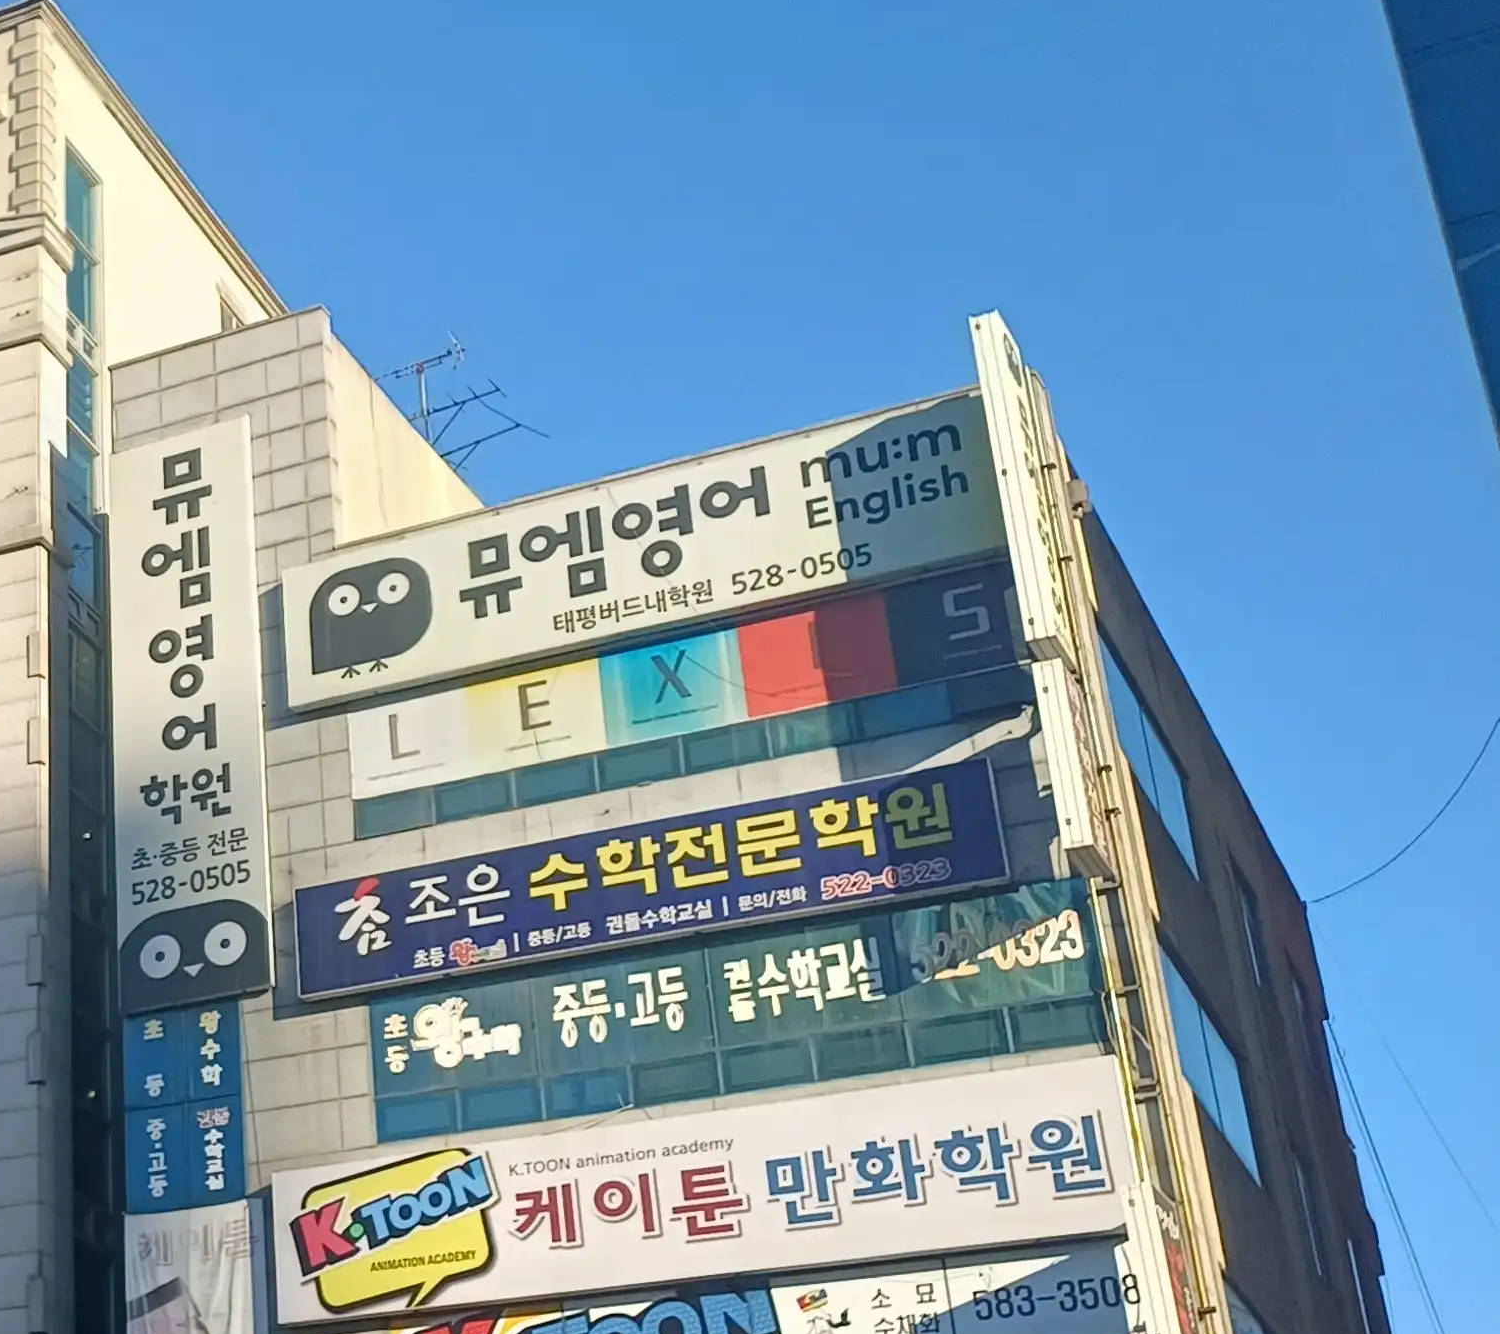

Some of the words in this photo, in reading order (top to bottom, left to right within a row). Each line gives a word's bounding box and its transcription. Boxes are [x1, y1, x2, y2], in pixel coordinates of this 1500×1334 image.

[806, 464, 970, 530] English
[459, 466, 771, 619] 뮤엠영어
[141, 448, 217, 750] 뮤엠영어
[553, 578, 714, 635] 태평버드내학원
[732, 543, 873, 597] 528-0505
[140, 763, 232, 825] 학원
[208, 828, 250, 857] 전문
[405, 864, 511, 927] 조은
[529, 783, 953, 911] 수학전문학원
[131, 859, 252, 907] 528-0505
[820, 857, 952, 901] 522-0323
[511, 1161, 748, 1245] 케이툰
[764, 1113, 1110, 1229] 만화학원
[575, 1147, 657, 1169] animation
[660, 1135, 736, 1161] academy
[370, 1255, 426, 1274] ANIMATION
[427, 1249, 478, 1268] ACADEMY
[973, 1273, 1141, 1322] 583-3508
